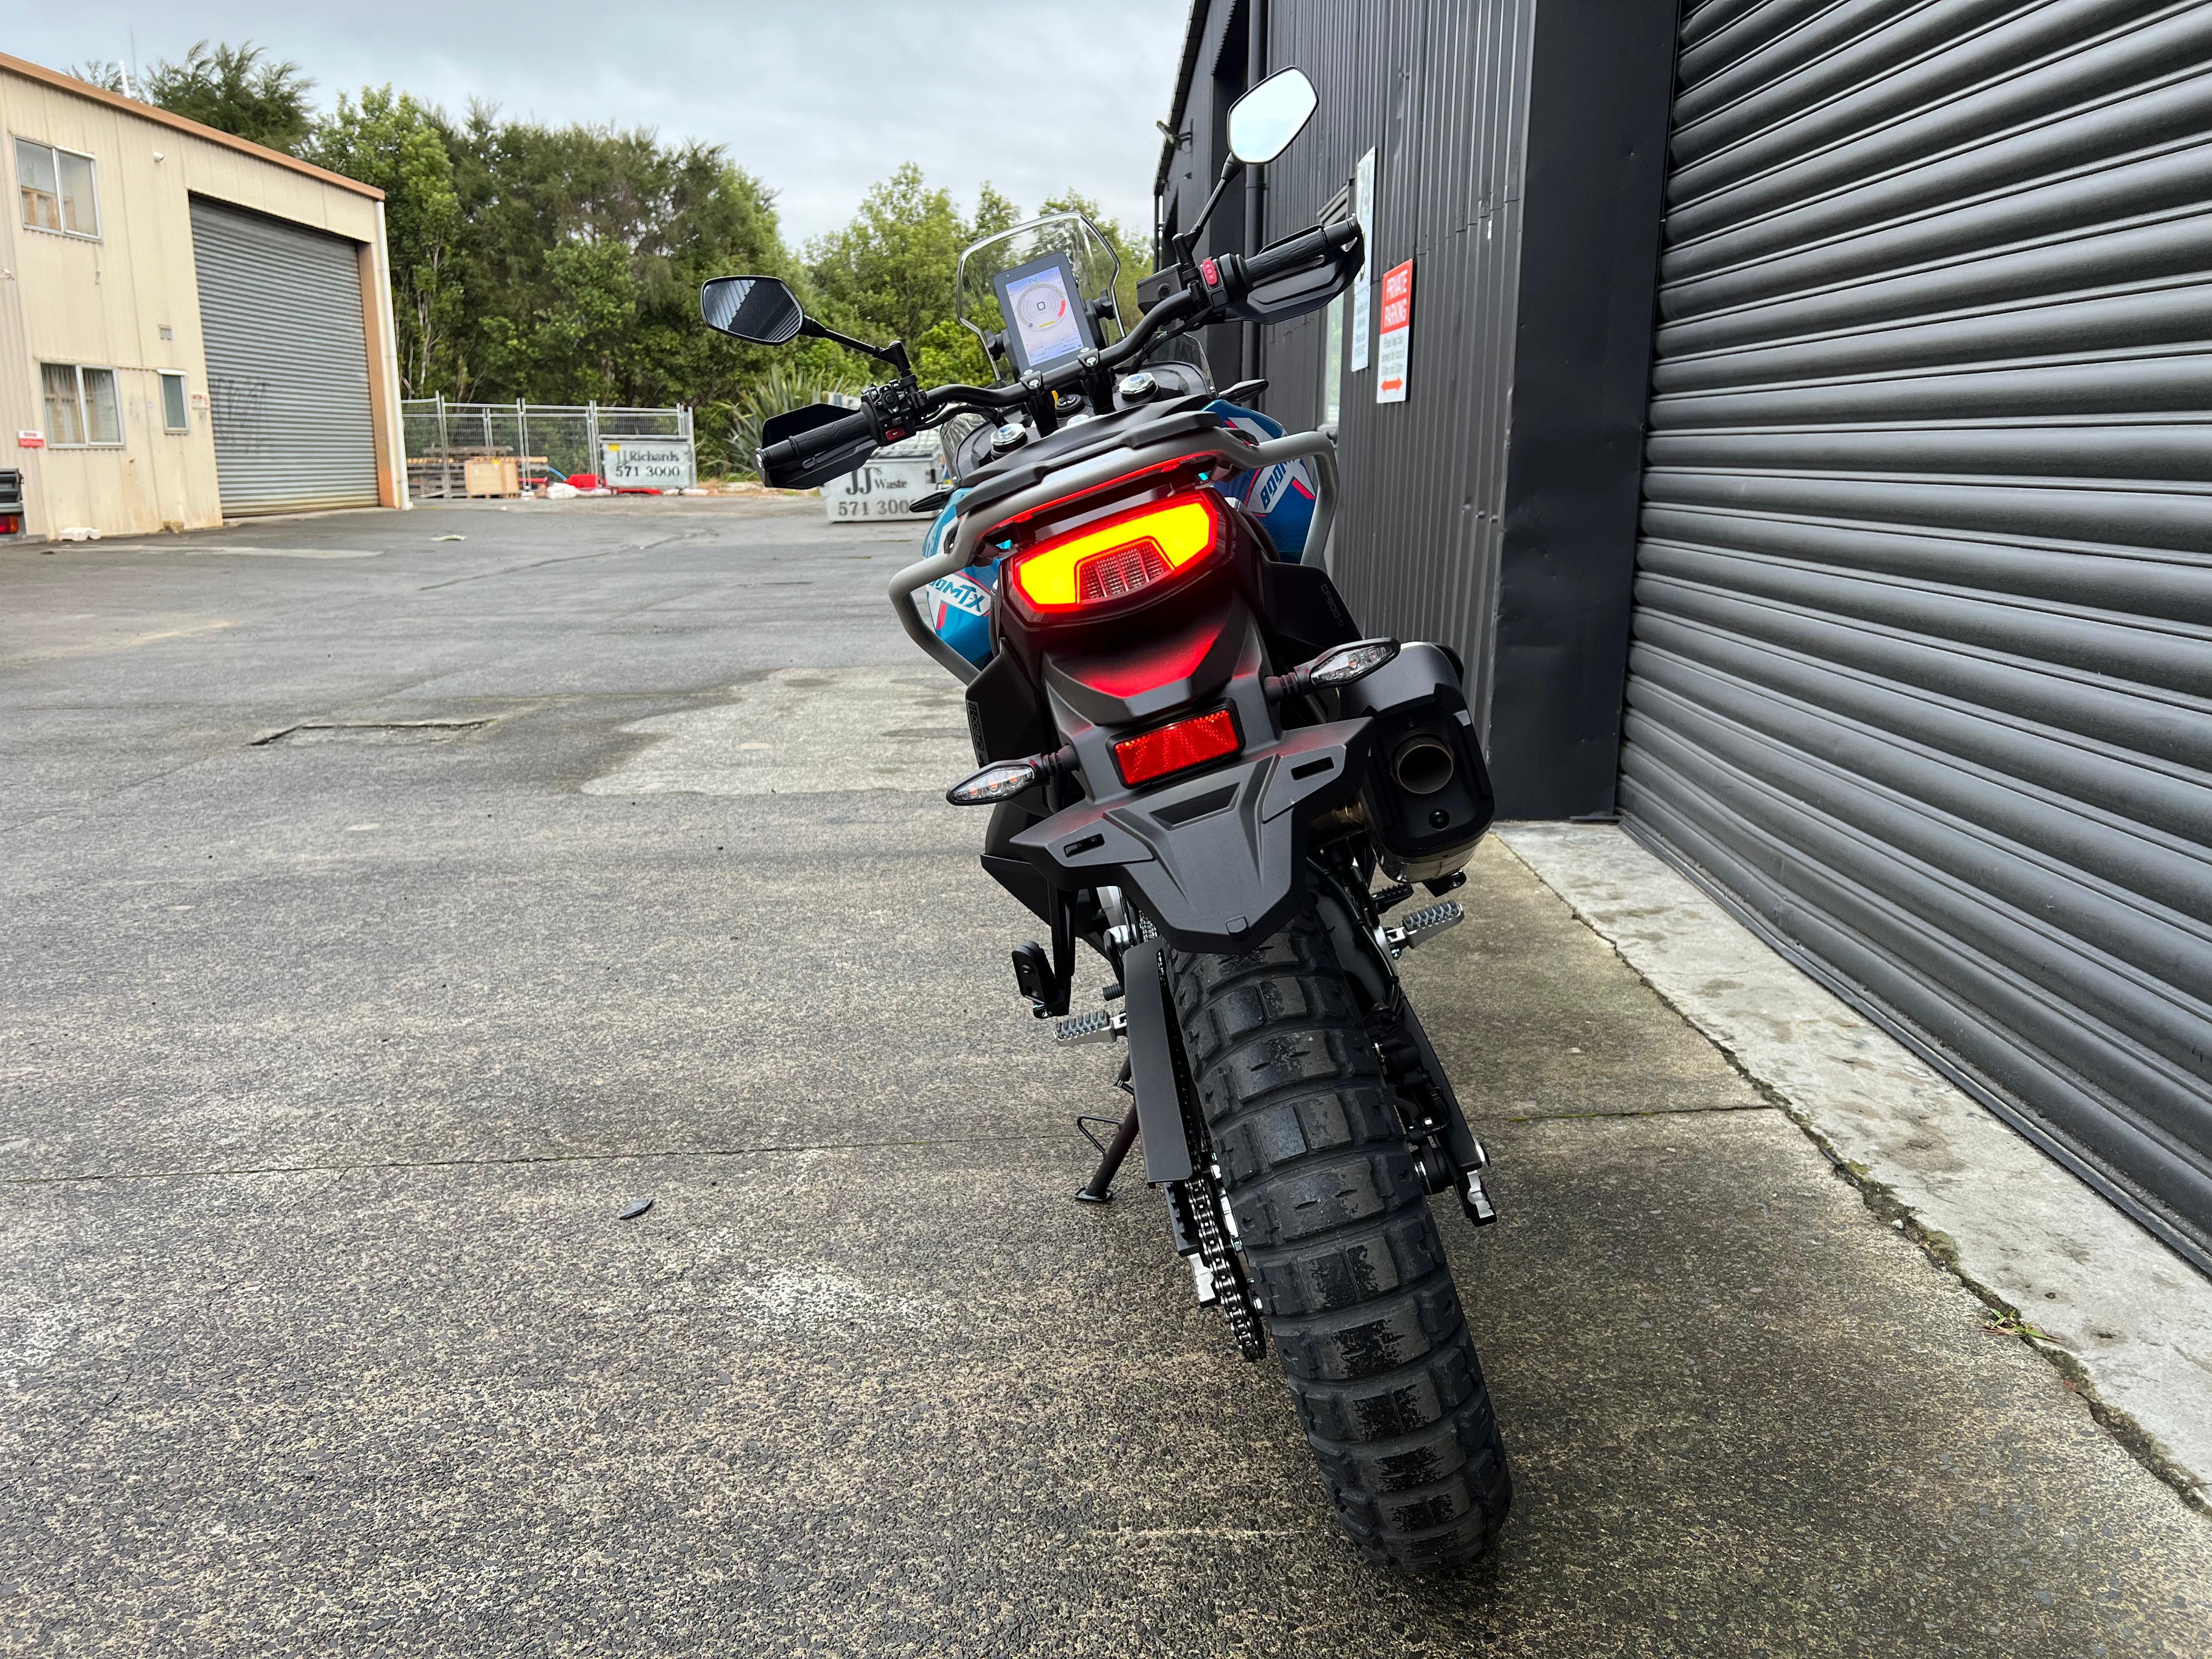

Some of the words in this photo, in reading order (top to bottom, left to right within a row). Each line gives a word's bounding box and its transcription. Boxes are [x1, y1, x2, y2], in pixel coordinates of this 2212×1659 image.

[1384, 298, 1407, 328] PARKING
[615, 466, 639, 477] 571
[646, 466, 680, 476] 3000
[874, 478, 907, 489] Waste
[839, 501, 869, 516] 571
[877, 496, 916, 515] 300
[929, 578, 985, 613] 0MTX
